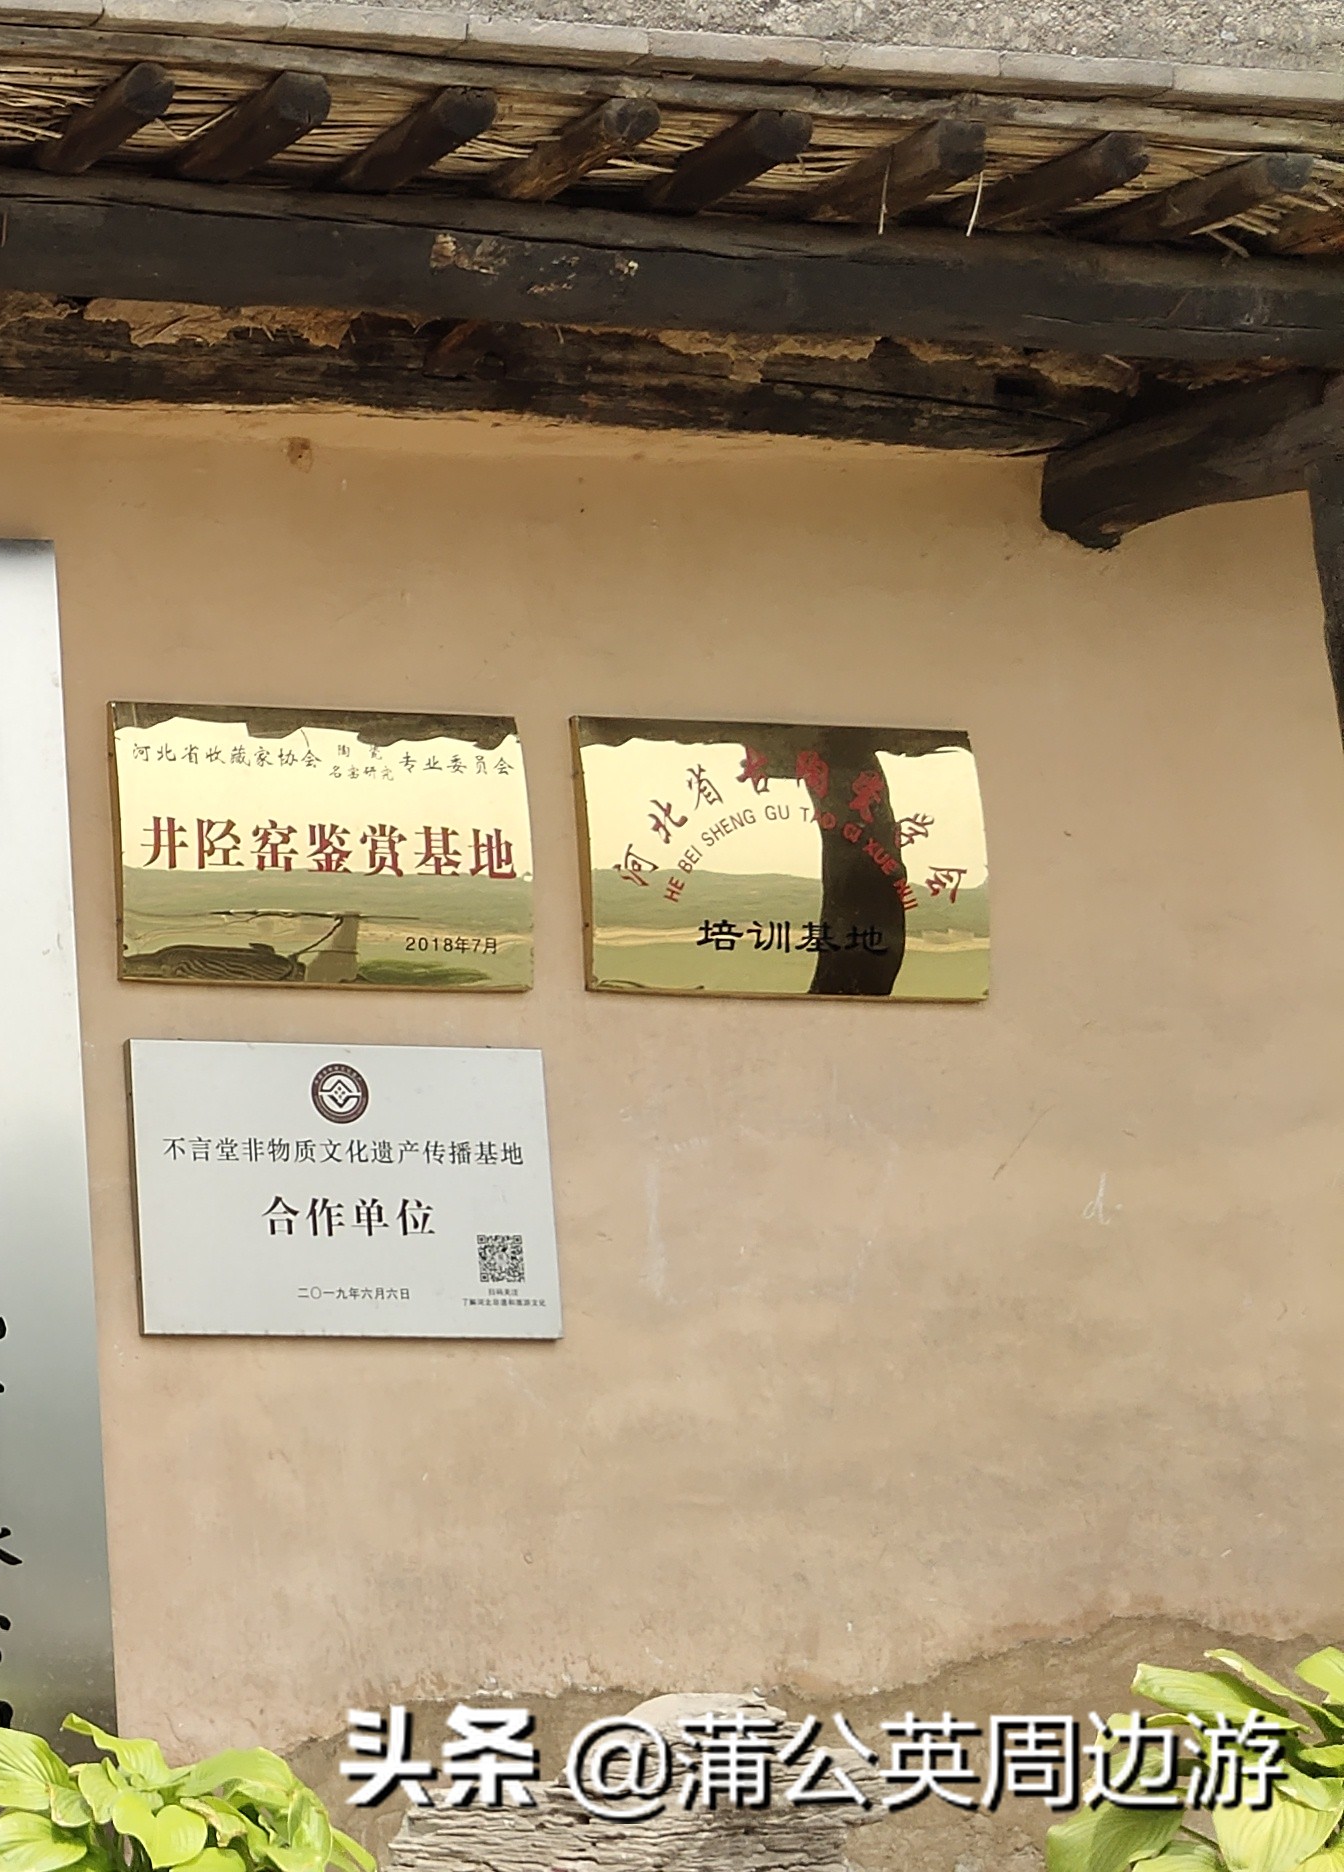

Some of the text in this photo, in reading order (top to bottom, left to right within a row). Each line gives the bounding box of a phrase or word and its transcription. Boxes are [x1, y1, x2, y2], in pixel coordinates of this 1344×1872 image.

[132, 741, 322, 769] 河北省收藏家协会
[398, 752, 515, 776] 专业委员会
[141, 815, 518, 880] 井陉窑鉴赏基地
[664, 875, 685, 903] HE
[677, 844, 703, 874] BEI
[700, 807, 758, 848] SHENG
[765, 804, 791, 822] GU
[405, 935, 498, 956] 2018年7月
[696, 919, 889, 957] 培训基地
[162, 1136, 524, 1167] 不言堂非物质文化遗产传播基地
[262, 1195, 436, 1238] 合作单位
